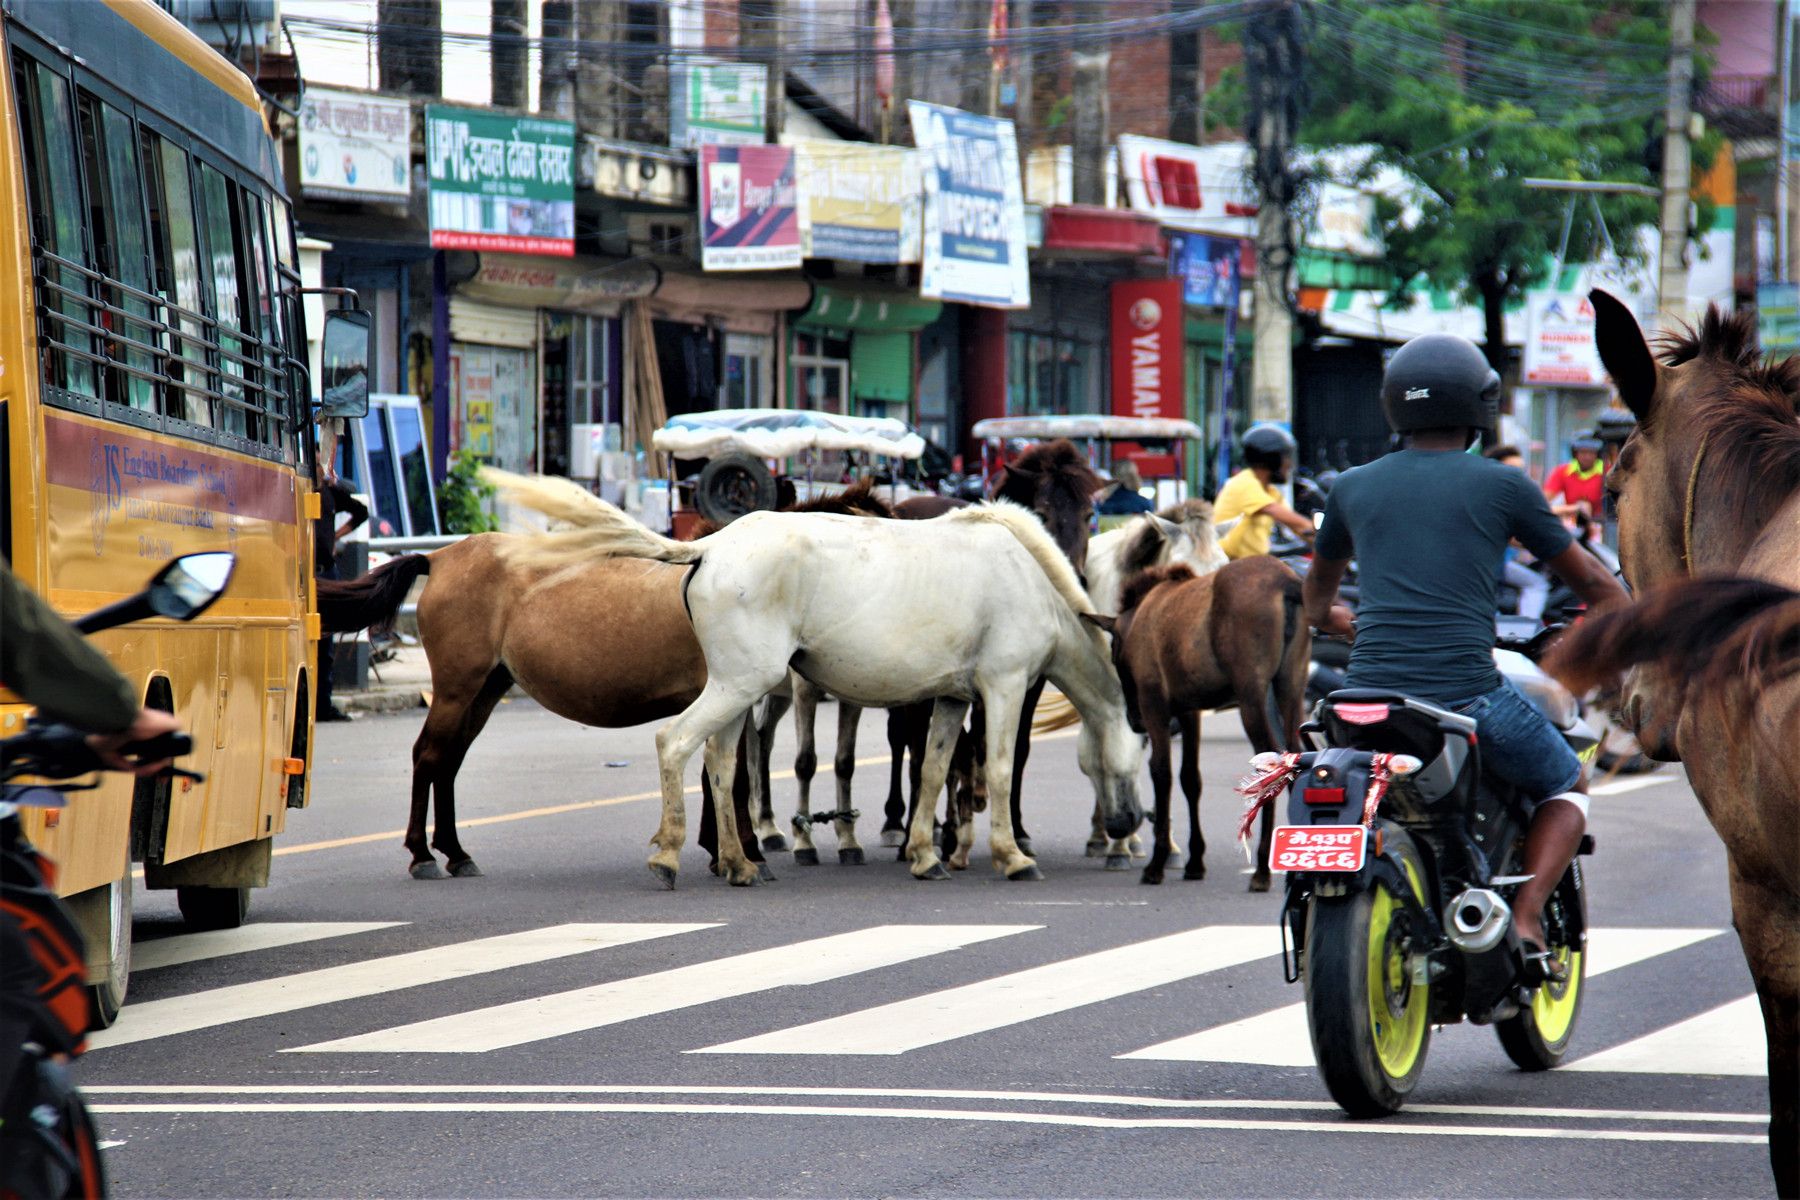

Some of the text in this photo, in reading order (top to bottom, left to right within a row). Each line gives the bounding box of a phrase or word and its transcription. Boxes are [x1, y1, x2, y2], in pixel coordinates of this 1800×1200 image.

[429, 118, 470, 183] UPVC
[1132, 332, 1161, 418] YAMAH
[104, 444, 121, 523] JS
[123, 447, 226, 495] English Boarding School
